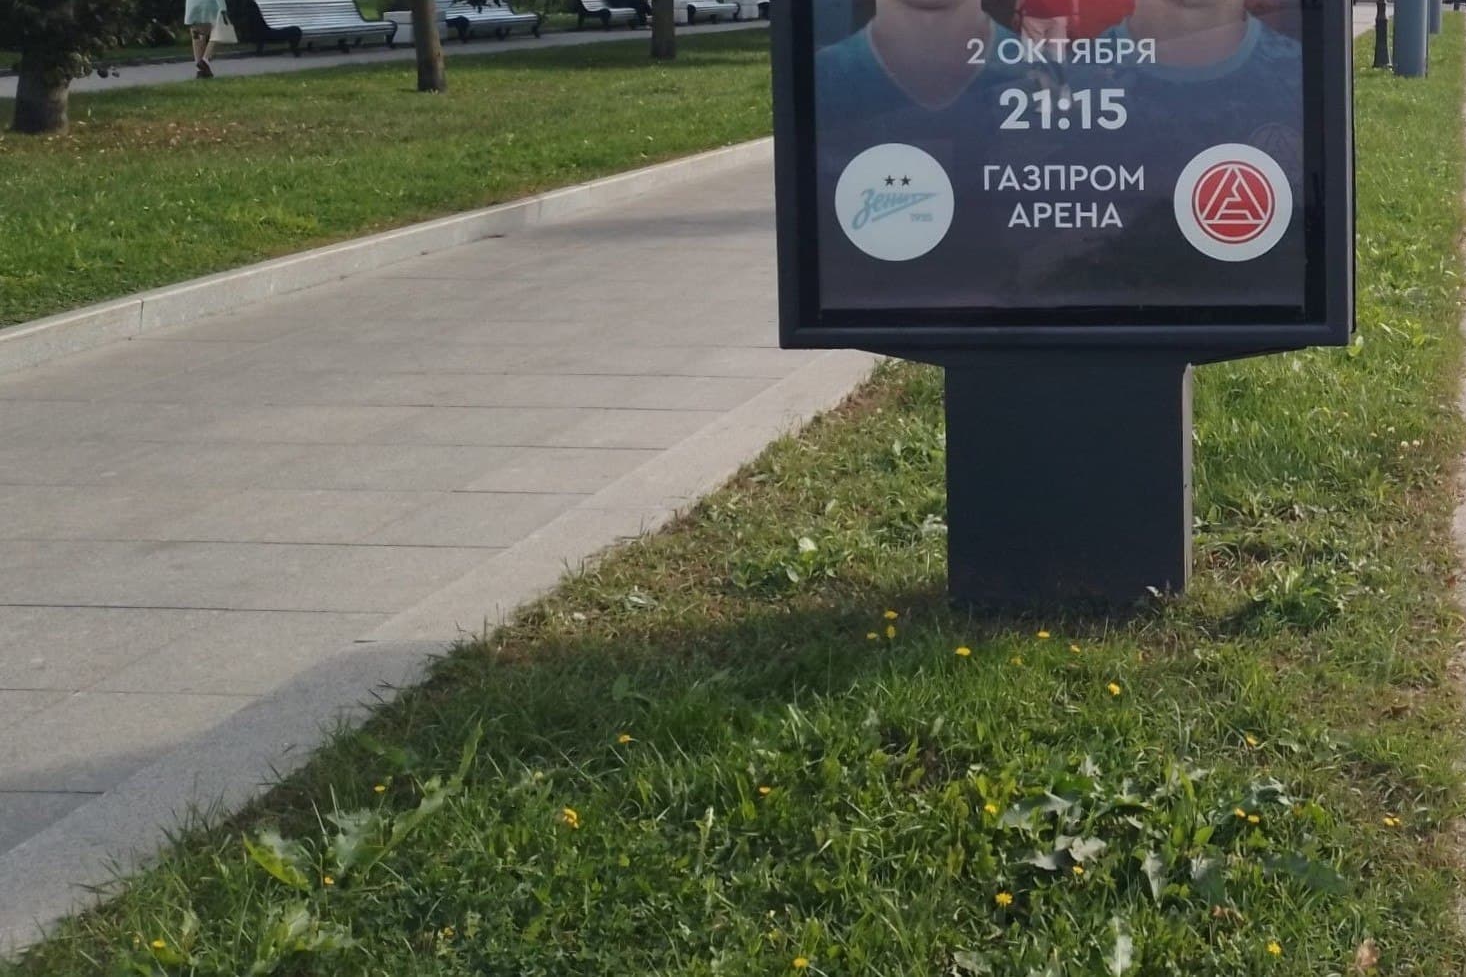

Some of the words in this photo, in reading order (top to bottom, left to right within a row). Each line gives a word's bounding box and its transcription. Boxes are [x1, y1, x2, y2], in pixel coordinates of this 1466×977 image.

[966, 37, 986, 64] 2
[997, 37, 1157, 64] ОКТЯБРЯ
[999, 88, 1128, 130] 21:15
[983, 164, 1145, 191] ГАЗПРОМ
[1008, 202, 1123, 228] АРЕНА
